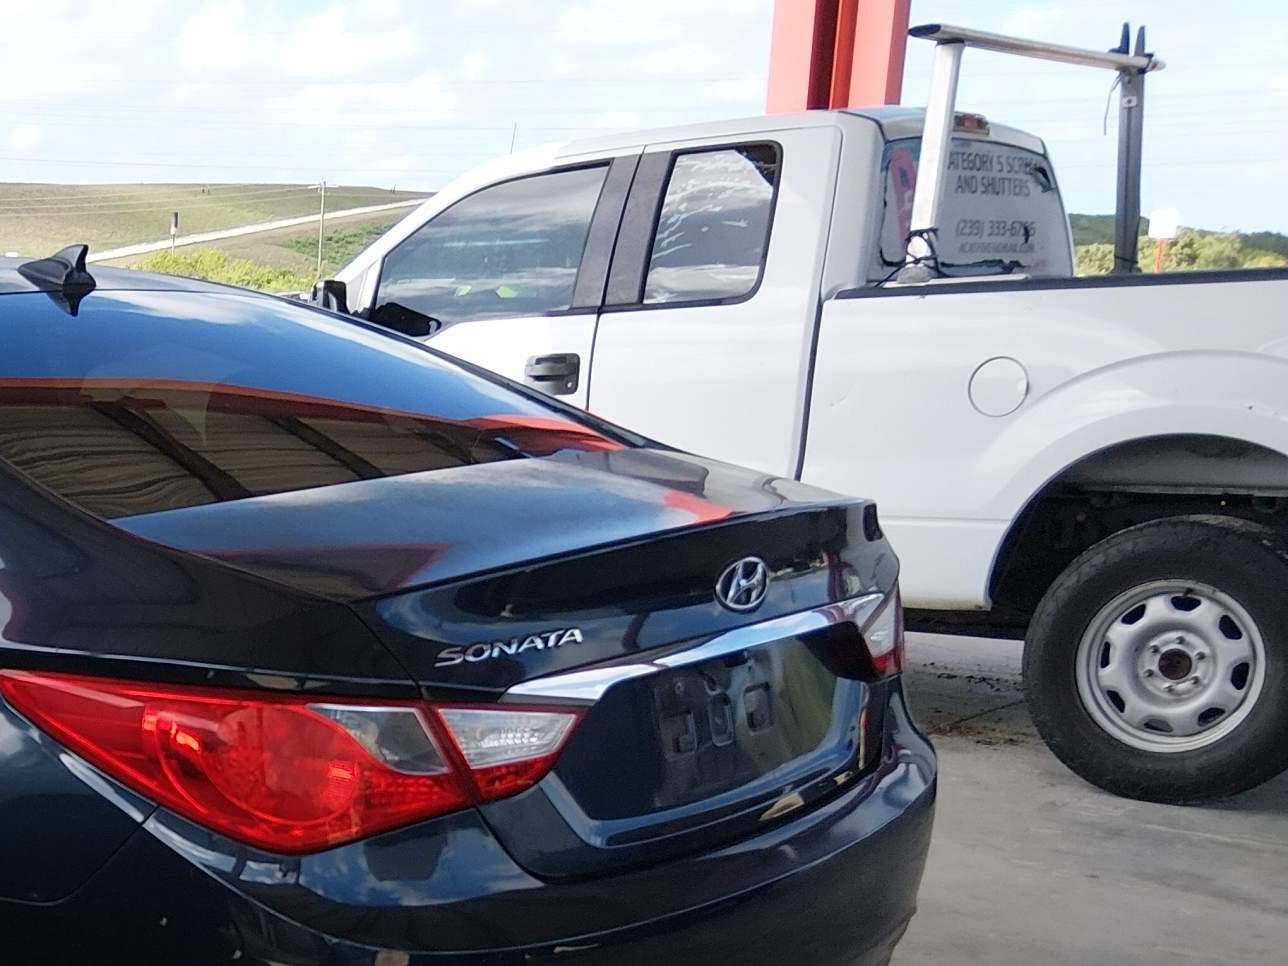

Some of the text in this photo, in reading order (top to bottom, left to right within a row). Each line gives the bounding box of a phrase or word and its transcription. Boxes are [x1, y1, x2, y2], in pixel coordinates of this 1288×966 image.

[947, 151, 994, 172] ATEGORY
[955, 174, 1032, 197] AND SHUTTERS
[434, 628, 584, 668] SONATA
